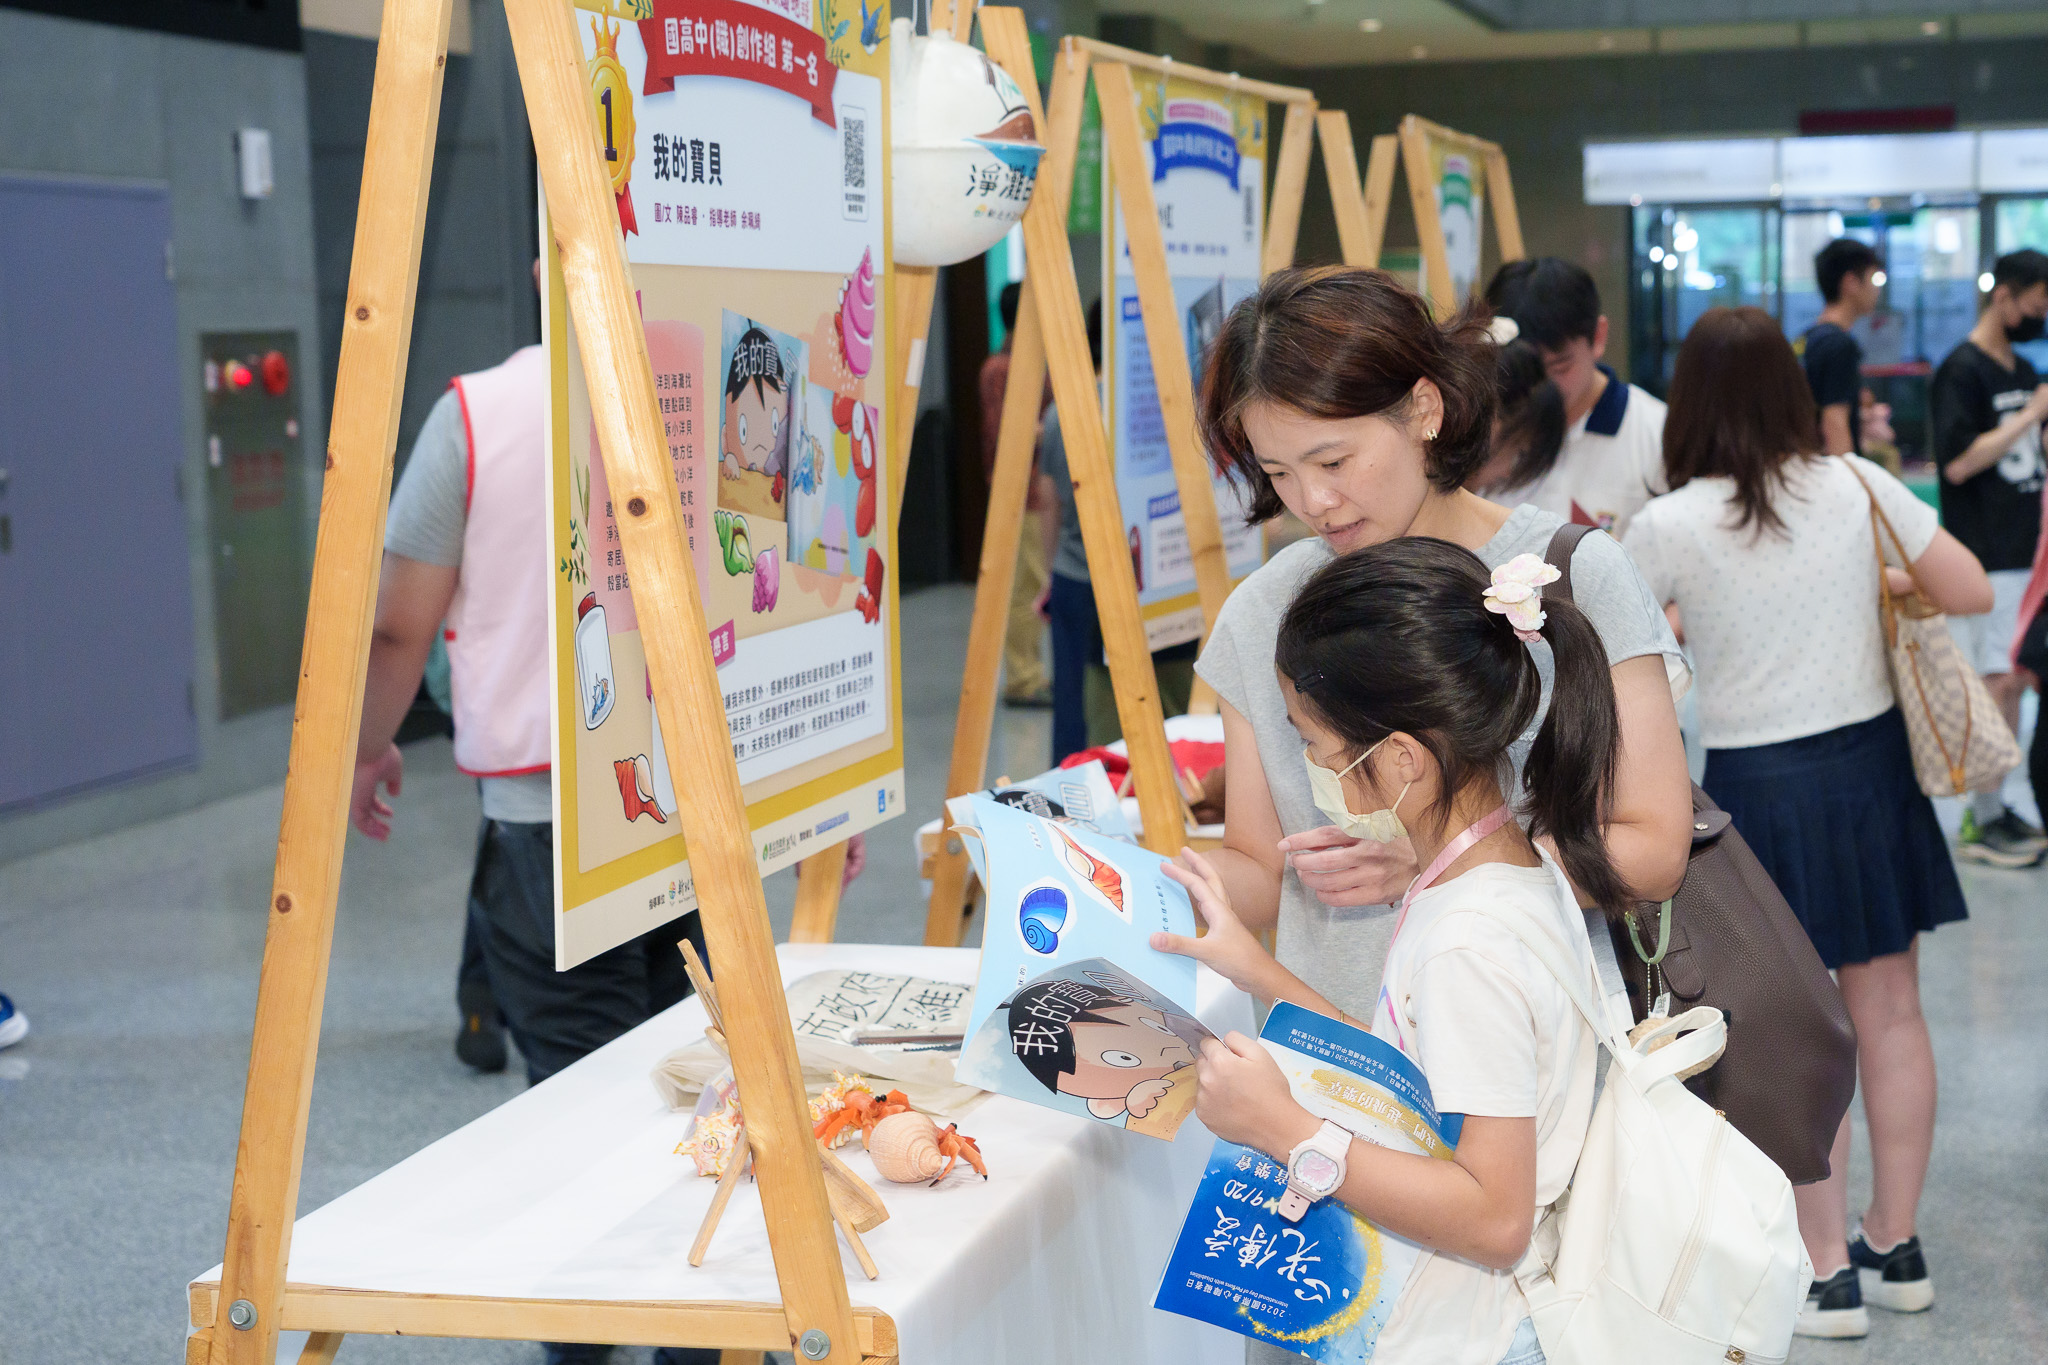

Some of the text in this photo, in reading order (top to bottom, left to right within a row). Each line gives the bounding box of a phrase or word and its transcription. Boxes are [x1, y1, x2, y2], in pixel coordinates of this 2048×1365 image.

[664, 17, 819, 87] 國高中(職)創作組 第一名
[600, 87, 618, 162] 1
[653, 133, 723, 187] 我的寶貝
[1012, 969, 1167, 1057] 我的寶貝
[1329, 1080, 1437, 1150] 我們一起飛的樂章
[1234, 1154, 1289, 1186] 音樂會
[1223, 1178, 1264, 1206] 9/20
[1189, 1270, 1214, 1285] Disabilities
[1224, 1281, 1243, 1294] Persons
[1186, 1278, 1286, 1318] 2026國際身心障礙者日
[1258, 1293, 1289, 1308] International
